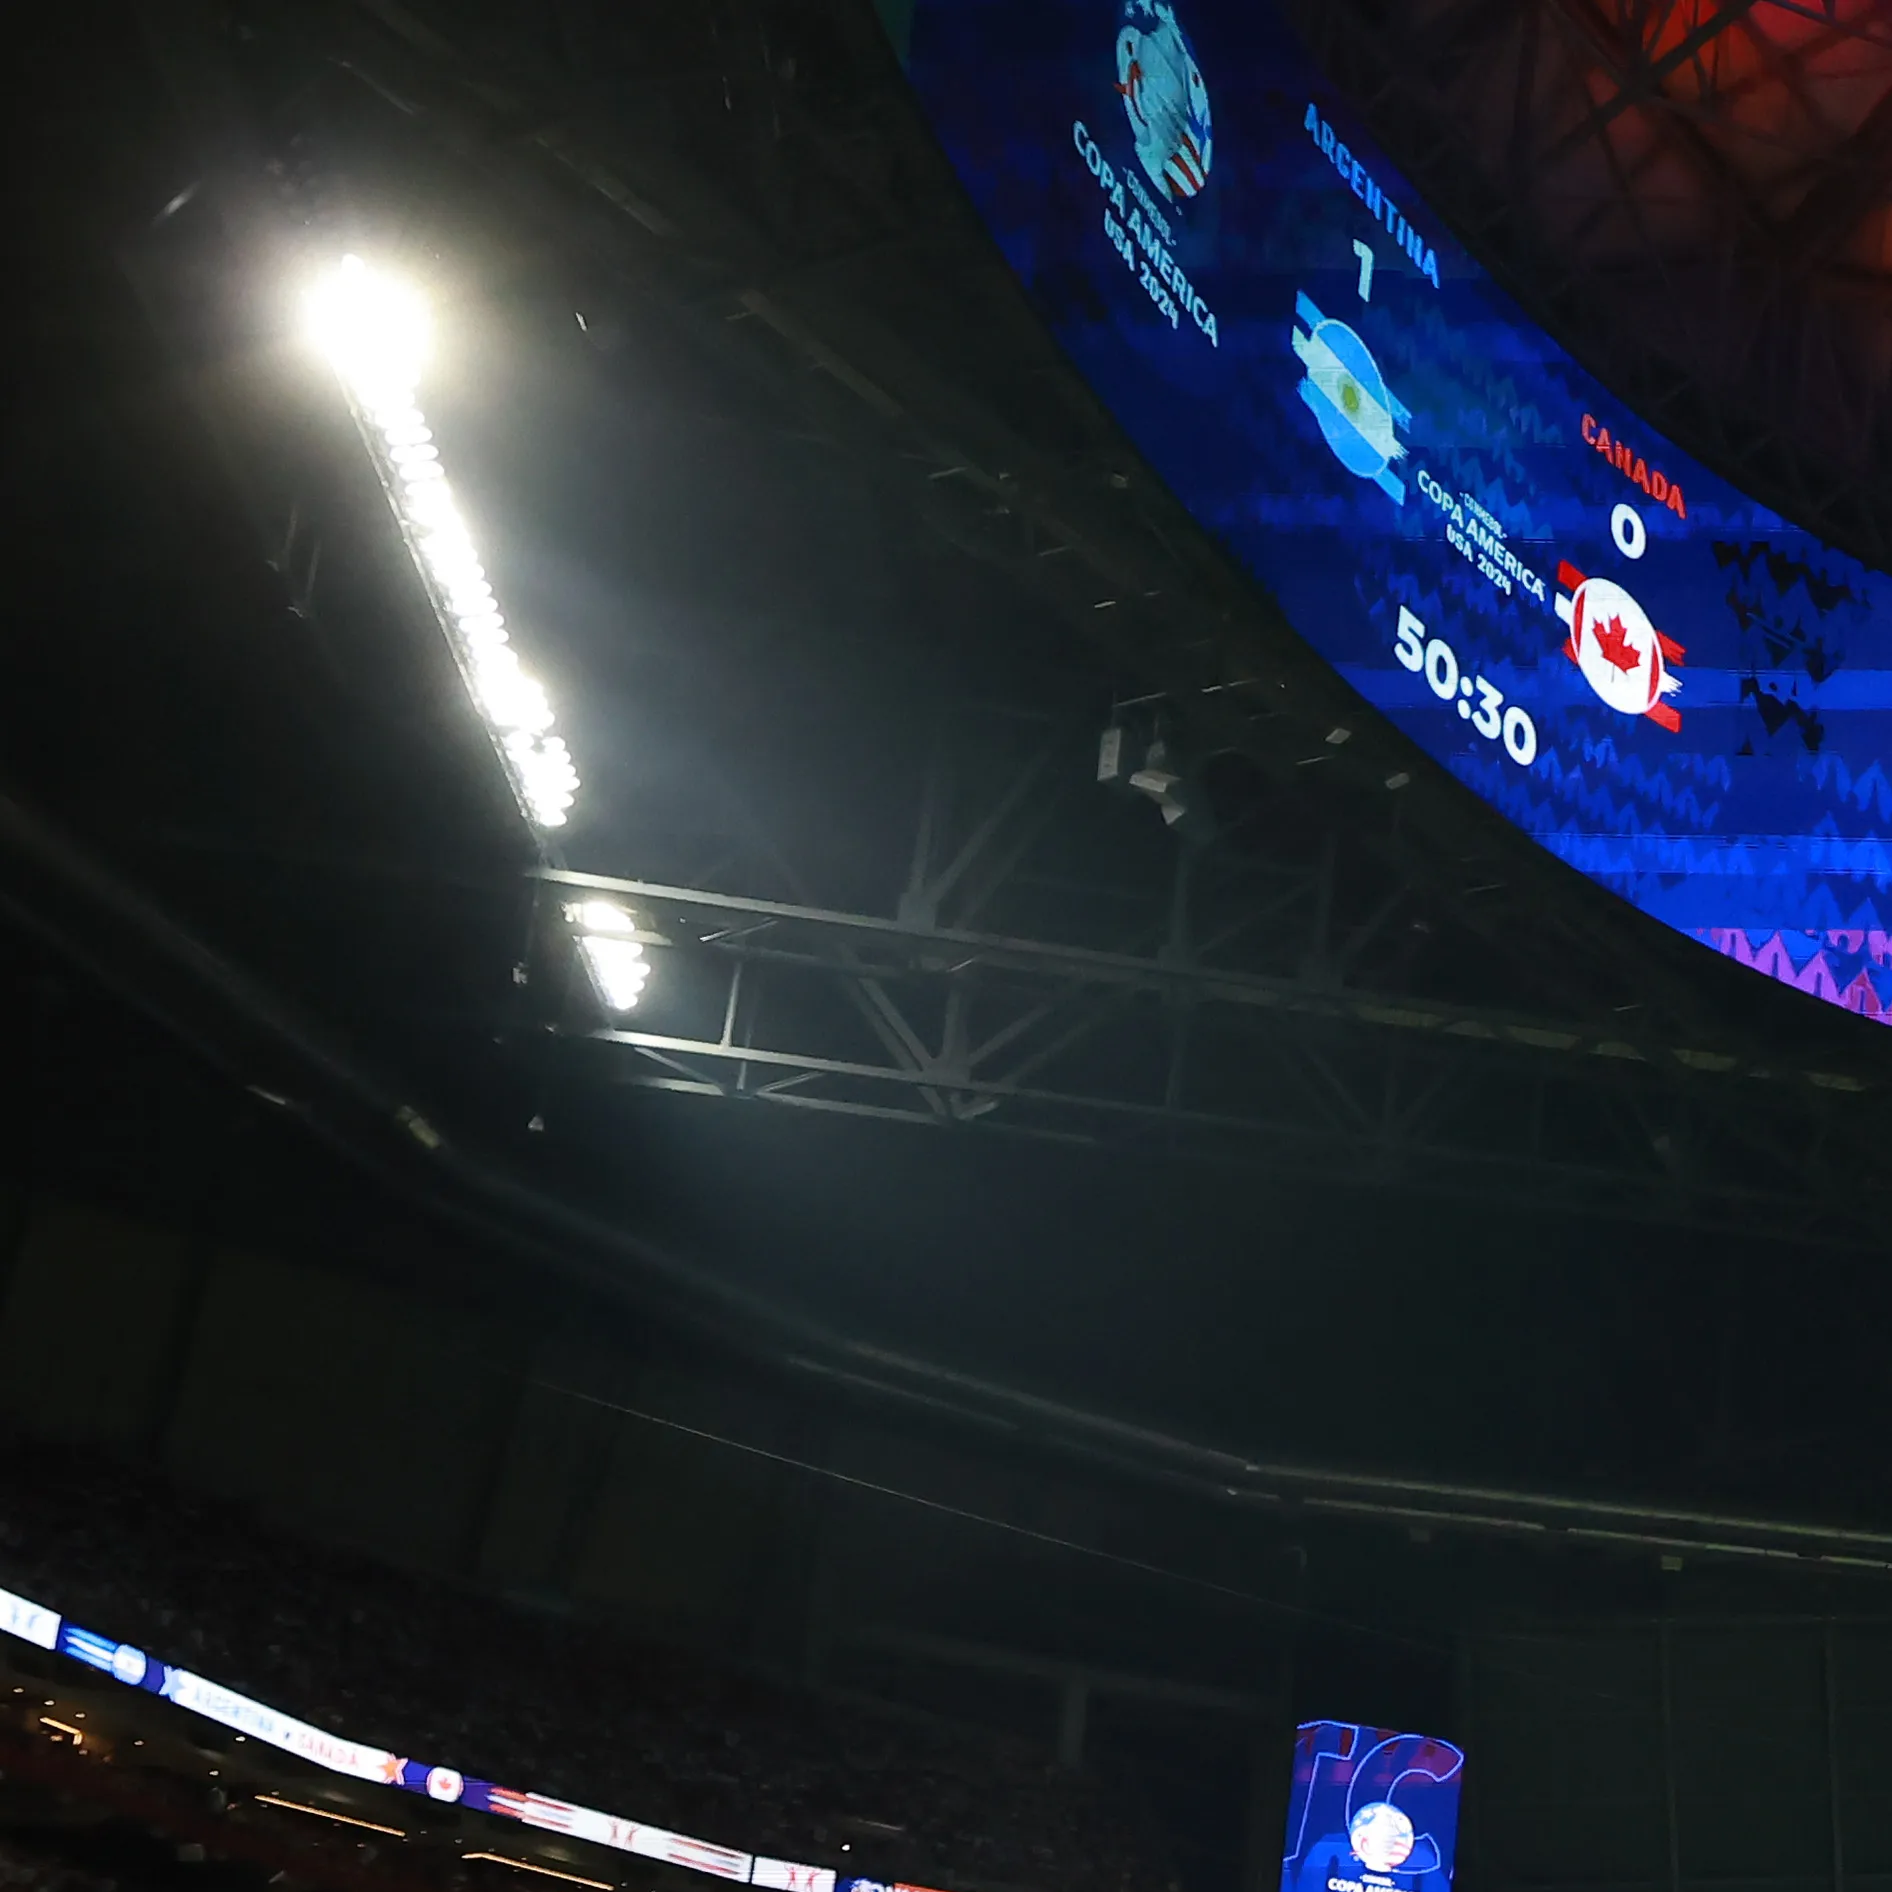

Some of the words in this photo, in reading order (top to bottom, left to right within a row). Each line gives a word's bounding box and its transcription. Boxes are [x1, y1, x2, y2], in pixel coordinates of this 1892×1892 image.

[1073, 120, 1126, 219] COPA
[1127, 207, 1218, 348] AMERICA
[1304, 102, 1440, 289] ARGENTINA
[1104, 208, 1135, 272] USA
[1139, 261, 1179, 330] 2024
[1352, 238, 1373, 303] 1
[1581, 412, 1687, 520] CANADA
[1417, 469, 1464, 529] COPA
[1466, 517, 1547, 602] AMERICA
[1446, 523, 1474, 563] USA
[1477, 553, 1512, 596] 2024
[1610, 503, 1647, 561] 0
[1394, 604, 1538, 767] 50:30
